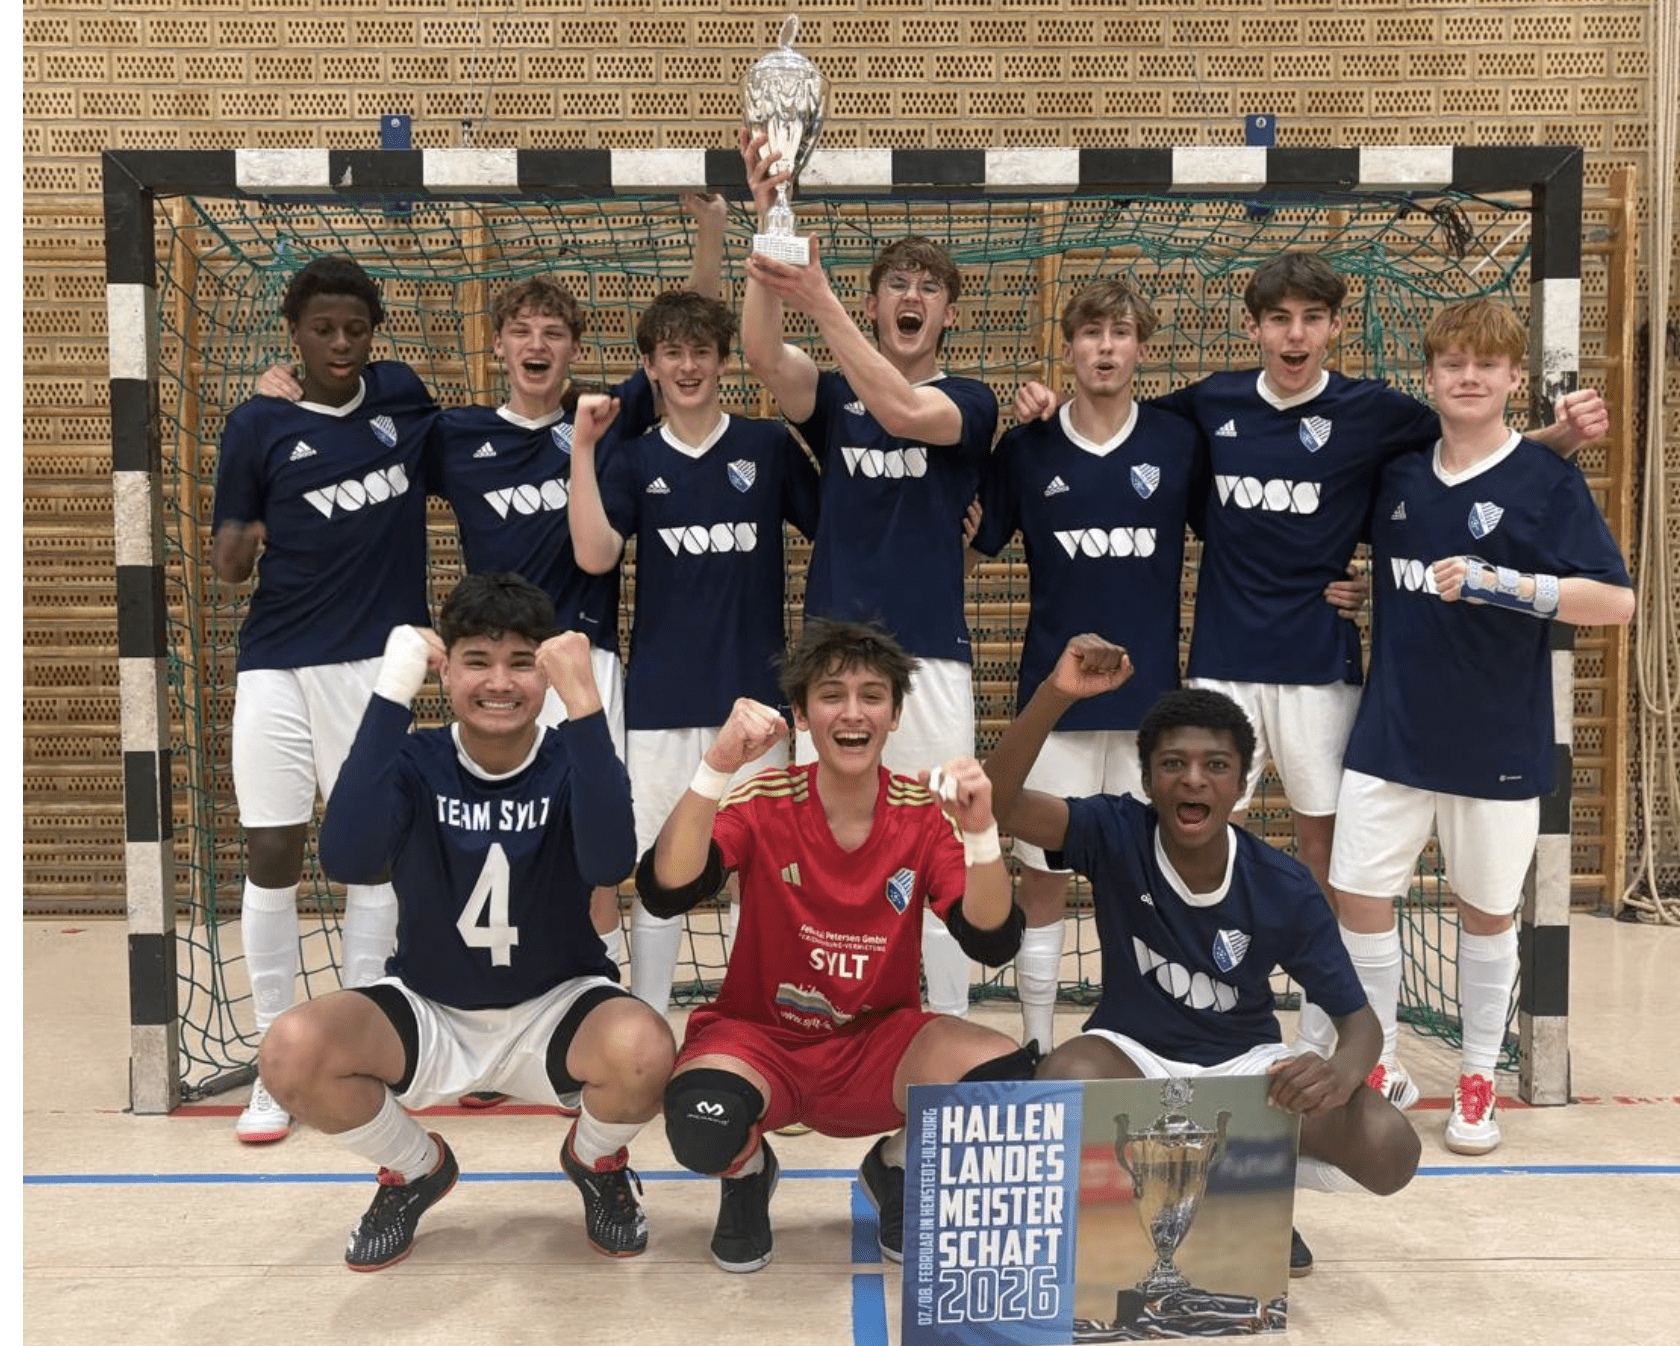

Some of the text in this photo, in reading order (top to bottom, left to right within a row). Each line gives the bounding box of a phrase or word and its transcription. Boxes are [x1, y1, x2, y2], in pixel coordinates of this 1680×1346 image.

[483, 478, 570, 520] VOS
[436, 793, 491, 831] TEAM
[456, 842, 519, 967] 4
[861, 933, 888, 945] GmbH
[809, 948, 869, 980] SYLT
[941, 1103, 1065, 1144] HALLEN
[941, 1144, 1065, 1185] LANDES
[917, 1108, 938, 1326] 07./08. FEBRUAR IN HENSTEDT-ULZBURG
[939, 1186, 1064, 1228] MEISTER
[938, 1228, 1063, 1268] SCHAFT
[937, 1266, 1060, 1323] 2026
